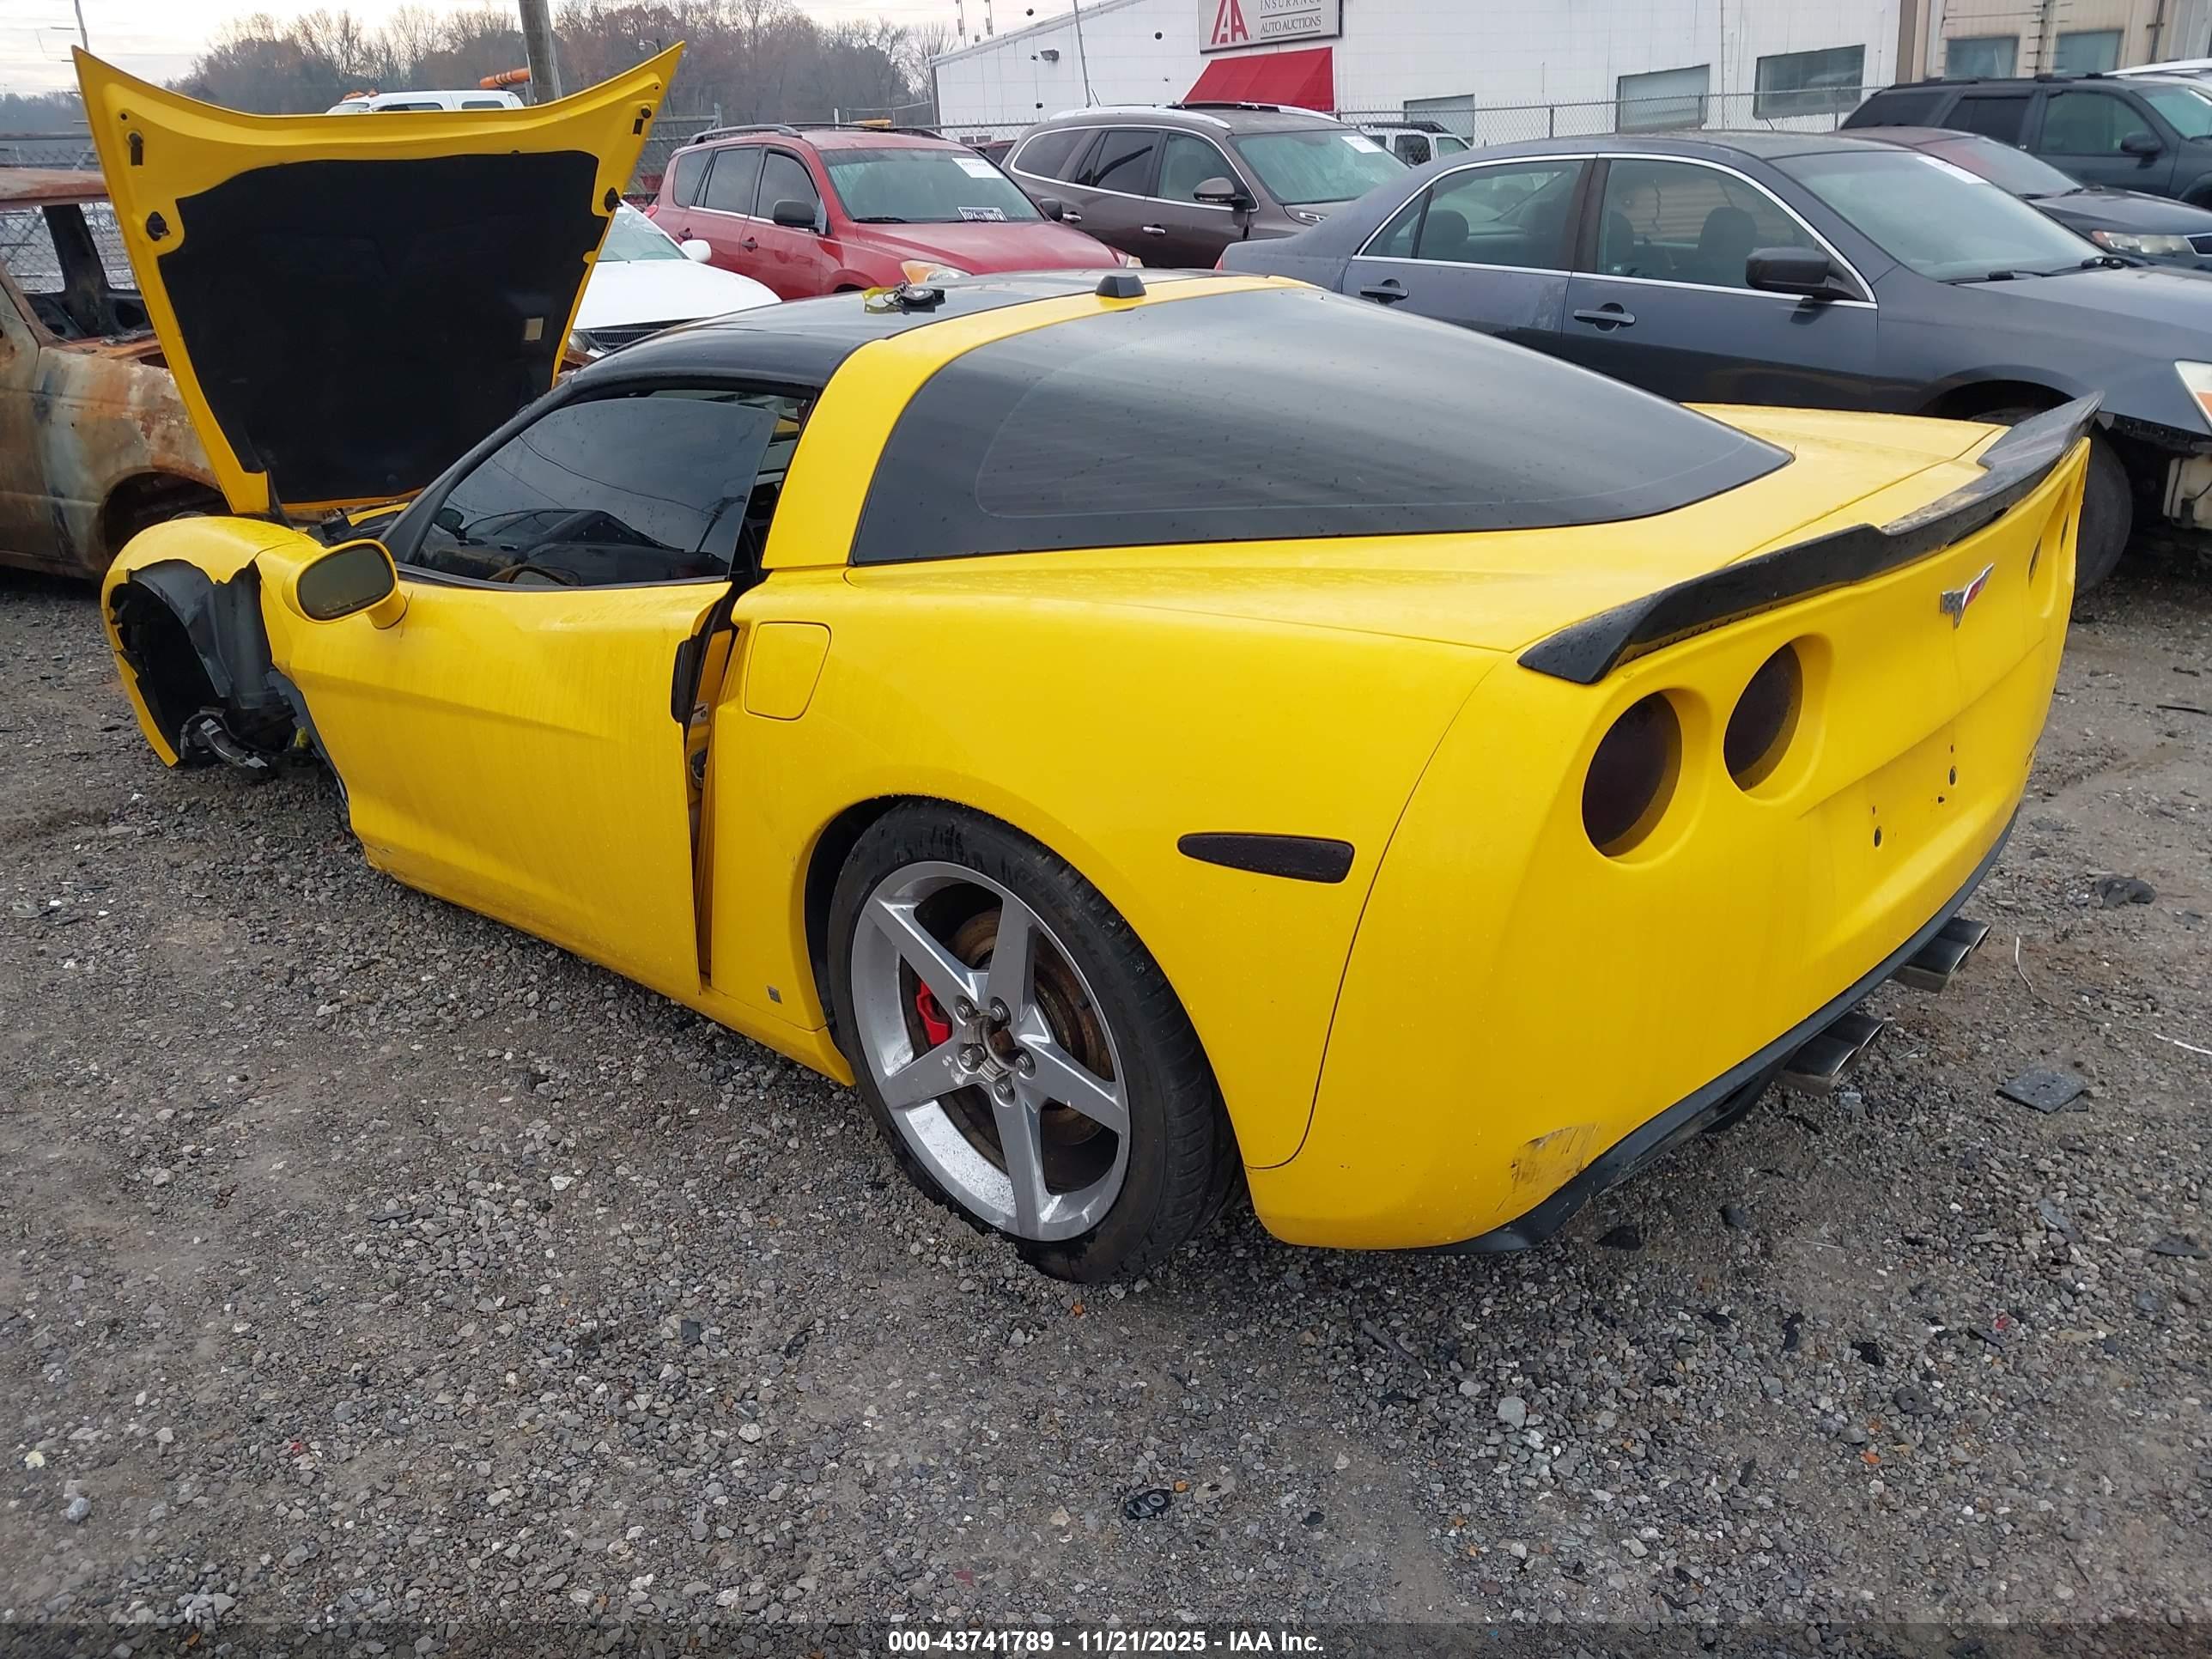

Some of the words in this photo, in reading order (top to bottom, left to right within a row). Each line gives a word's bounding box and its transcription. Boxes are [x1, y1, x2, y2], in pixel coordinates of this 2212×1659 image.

[1260, 0, 1322, 10] INSURA
[1261, 21, 1281, 33] AUTO
[1282, 15, 1322, 31] AUCTIONS
